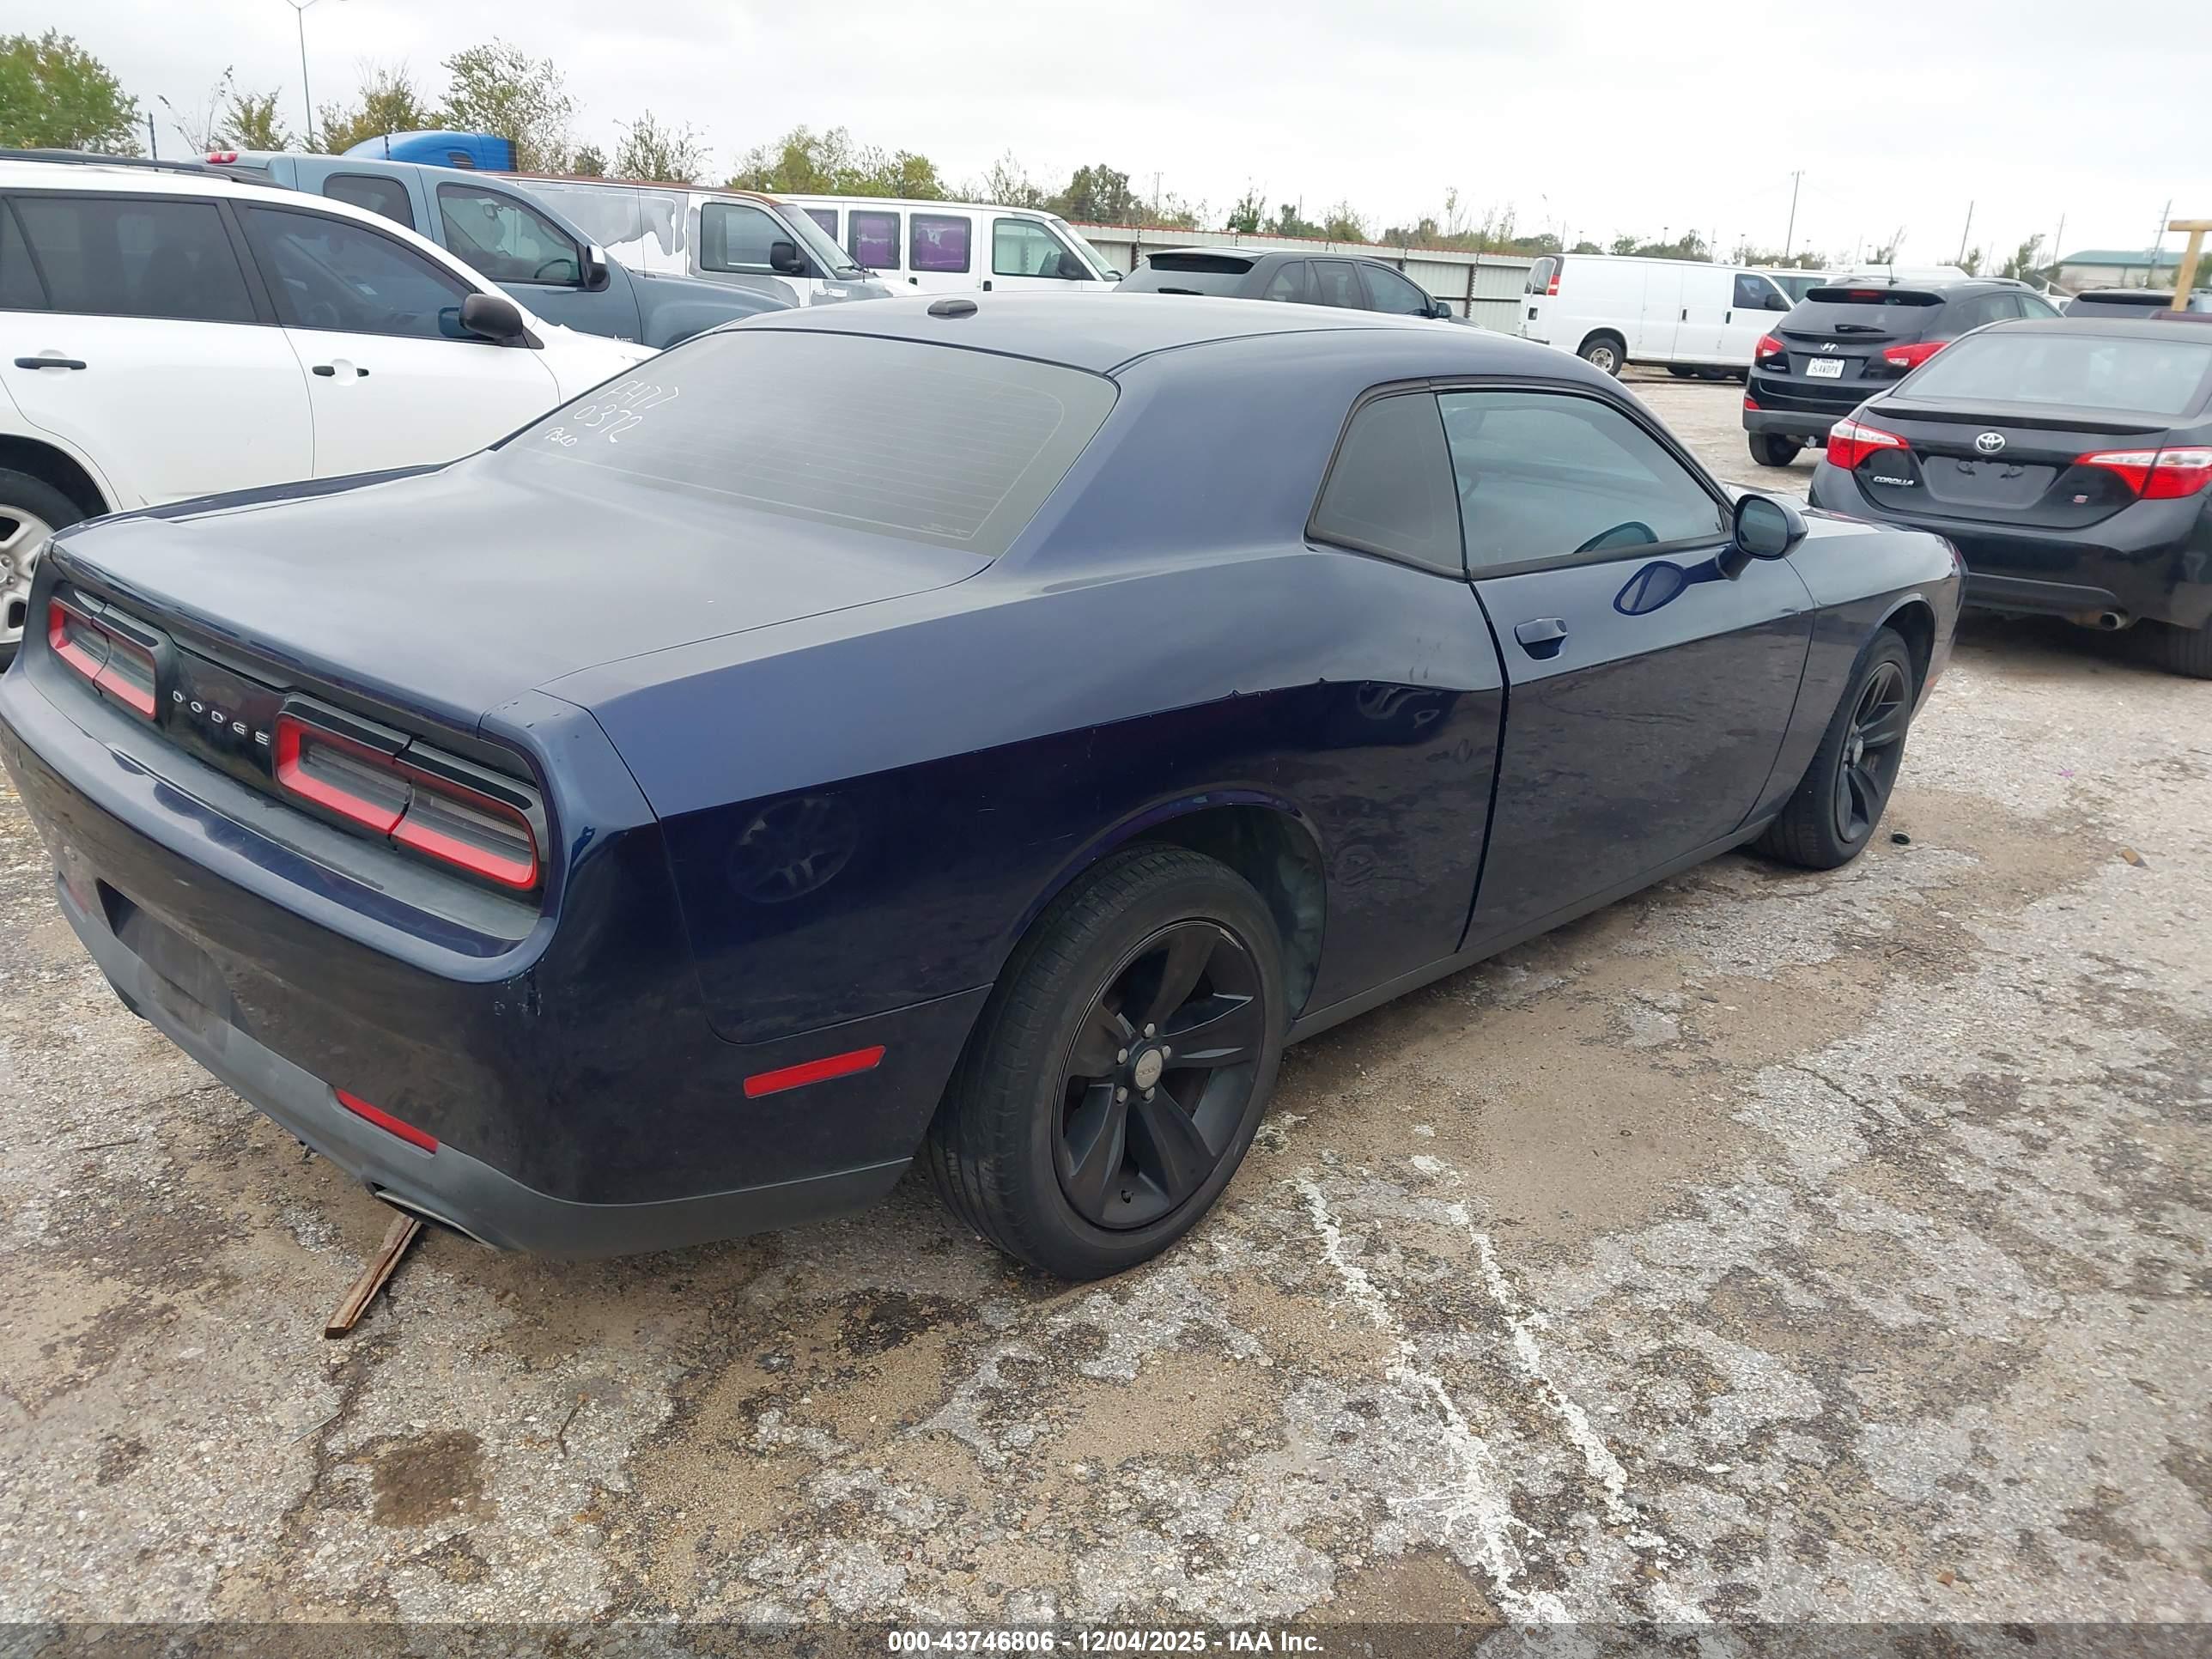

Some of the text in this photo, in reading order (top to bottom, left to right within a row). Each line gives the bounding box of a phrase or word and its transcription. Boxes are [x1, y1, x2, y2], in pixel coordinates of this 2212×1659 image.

[573, 404, 643, 444] 0372
[1873, 476, 1915, 486] COROLLA
[172, 690, 270, 746] DODGE
